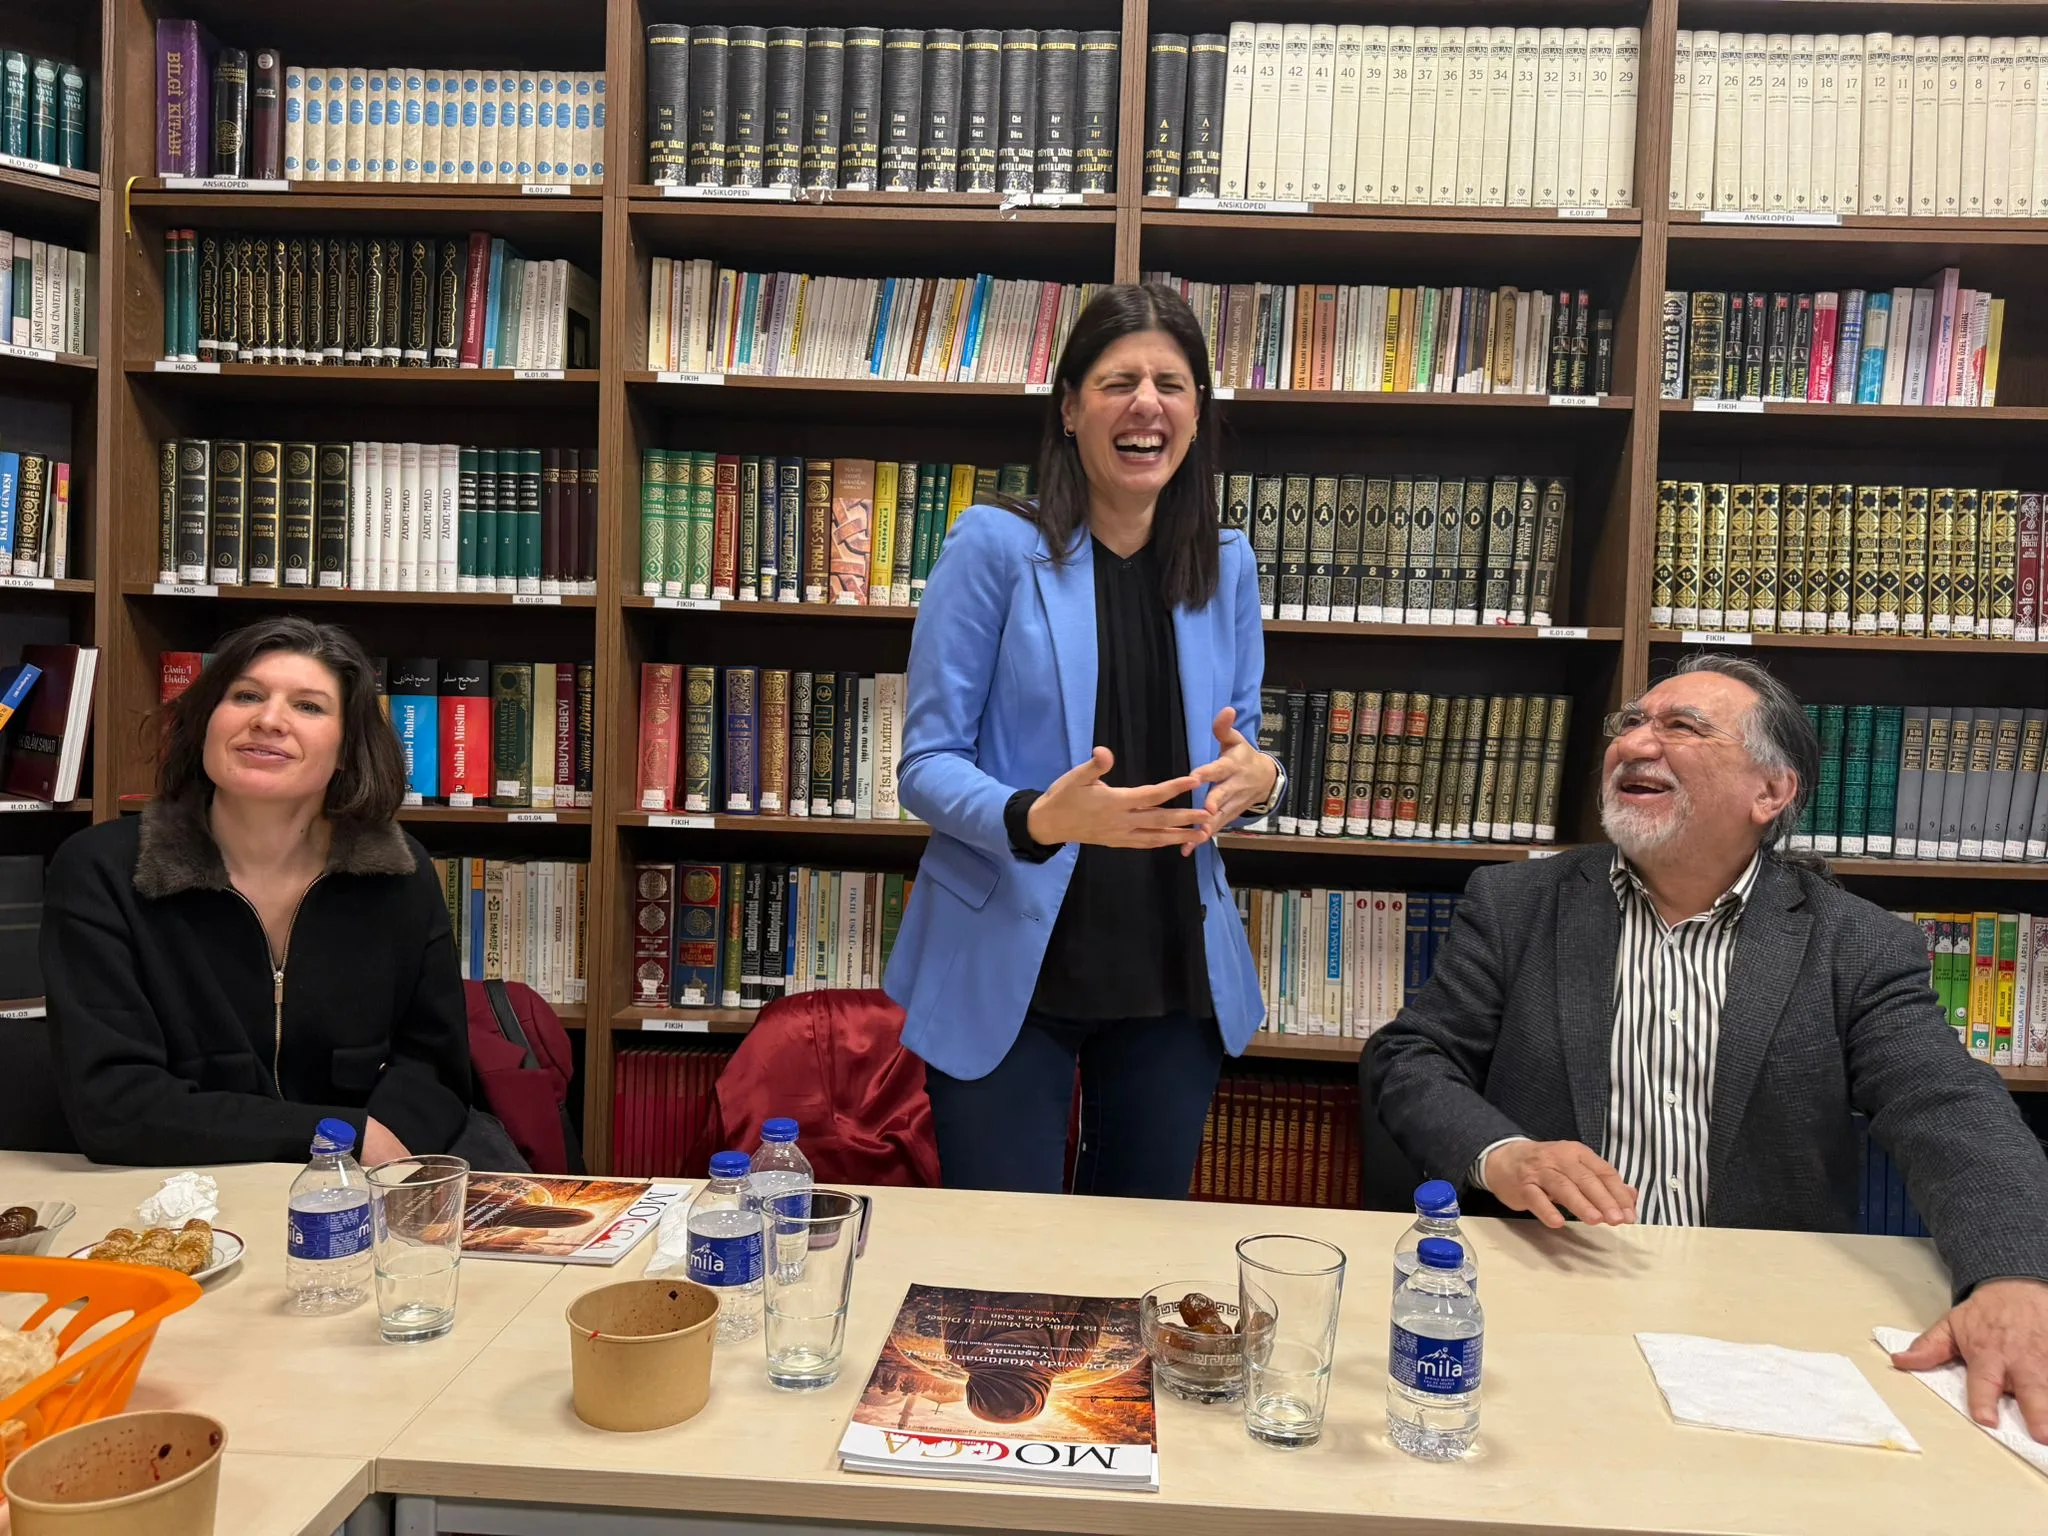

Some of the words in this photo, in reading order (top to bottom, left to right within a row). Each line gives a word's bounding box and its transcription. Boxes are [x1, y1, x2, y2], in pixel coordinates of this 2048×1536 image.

[167, 52, 184, 97] BİLGİ
[1232, 65, 1247, 75] 44
[1260, 66, 1275, 76] 43
[1288, 66, 1303, 77] 42
[1315, 67, 1329, 77] 41
[1341, 67, 1355, 78] 40
[1366, 68, 1381, 79] 39
[1392, 69, 1407, 79] 38
[1417, 69, 1433, 80] 37
[1443, 70, 1458, 81] 36
[1468, 69, 1484, 80] 35
[1493, 70, 1508, 80] 34
[1519, 71, 1534, 81] 33
[1543, 71, 1559, 82] 32
[1568, 71, 1582, 82] 31
[1592, 71, 1607, 81] 30
[1619, 71, 1634, 82] 29
[1674, 74, 1686, 84] 28
[1698, 75, 1713, 85] 27
[1724, 76, 1739, 86] 26
[1748, 76, 1763, 86] 25
[1772, 77, 1786, 87] 24
[1797, 78, 1809, 88] 19
[1821, 77, 1833, 88] 18
[1847, 78, 1858, 88] 17
[1874, 77, 1886, 87] 12
[1898, 79, 1908, 88] 11
[1922, 80, 1934, 89] 10
[1949, 80, 1957, 89] 9
[1975, 79, 1983, 89] 8
[1998, 81, 2006, 91] 7
[2023, 80, 2031, 90] 6
[1160, 119, 1169, 129] A
[1201, 118, 1210, 127] A
[168, 102, 184, 156] KİTABI
[1160, 133, 1168, 143] Z
[1201, 132, 1209, 142] Z
[35, 275, 43, 319] CİNAYETLER
[51, 280, 61, 322] CİNAYETLER
[1960, 311, 1970, 334] İLMİHAL
[33, 320, 43, 343] SİYASİ
[50, 322, 60, 345] SİYASİ
[1386, 315, 1397, 353] ALAMETLERİ
[1269, 321, 1277, 357] KADIN
[1958, 333, 1968, 356] ÖZEL
[1665, 324, 1680, 380] TEBLİĞ
[1383, 354, 1393, 383] KIYAMET
[680, 374, 699, 382] FIKIH
[1955, 356, 1966, 396] HANIMLARA
[1, 473, 12, 509] GÜNEŞİ
[1522, 500, 1530, 509] 2
[1292, 509, 1302, 522] V
[1346, 510, 1355, 522] Y
[1446, 512, 1456, 525] N
[1471, 513, 1480, 525] D
[880, 507, 889, 564] İLMİHALİ
[1523, 522, 1533, 560] EHLİYET
[1515, 526, 1525, 560] EMANET
[1541, 526, 1552, 561] EMANET
[1550, 523, 1560, 561] EHLİYET
[1260, 565, 1268, 573] 4
[1290, 565, 1297, 574] 5
[1317, 565, 1325, 574] 6
[1343, 566, 1350, 575] 7
[1369, 567, 1377, 575] 8
[1391, 569, 1399, 578] 9
[1414, 569, 1427, 578] 10
[1442, 569, 1450, 578] 11
[1465, 570, 1477, 578] 12
[1493, 570, 1504, 578] 13
[676, 600, 696, 608] FIKIH
[454, 704, 466, 741] Müslim
[881, 704, 893, 756] İLMİHALİ
[1904, 822, 1915, 831] 10
[1329, 929, 1340, 976] TOPLUMSAL
[2016, 1009, 2025, 1049] KADINLARA
[2021, 931, 2029, 959] ARSLAN
[690, 1253, 725, 1272] mila
[925, 1314, 961, 1324] Dieser
[991, 1313, 1013, 1321] Sein
[979, 1320, 1021, 1329] Muslim
[904, 1349, 953, 1361] Olarak
[985, 1347, 1050, 1359] Yaşamak
[956, 1355, 1035, 1367] Müslüman
[1038, 1360, 1106, 1371] Dünyada
[1417, 1359, 1463, 1377] mila
